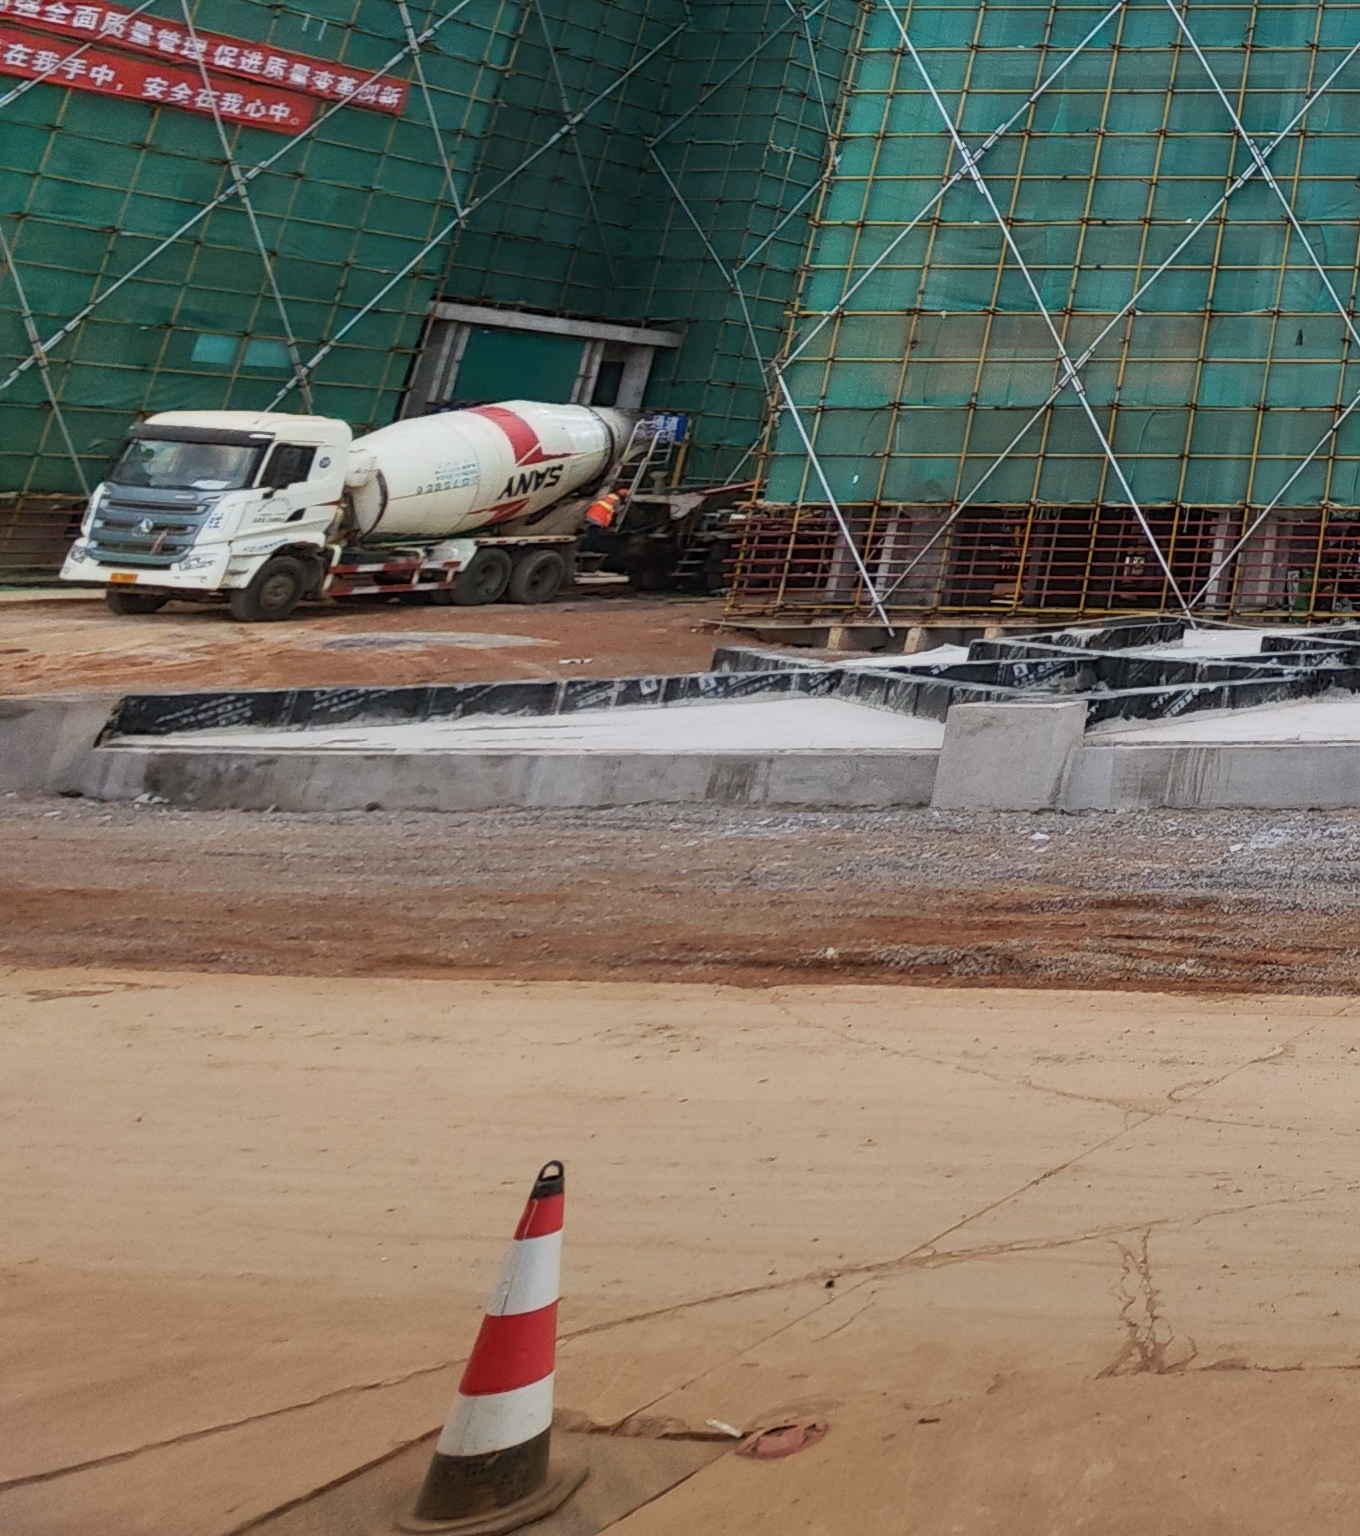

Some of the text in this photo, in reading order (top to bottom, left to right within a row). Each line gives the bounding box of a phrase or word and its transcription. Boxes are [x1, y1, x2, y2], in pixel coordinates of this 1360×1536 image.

[0, 39, 300, 126] 在我手中，安全在我心中。
[495, 464, 563, 500] SANY
